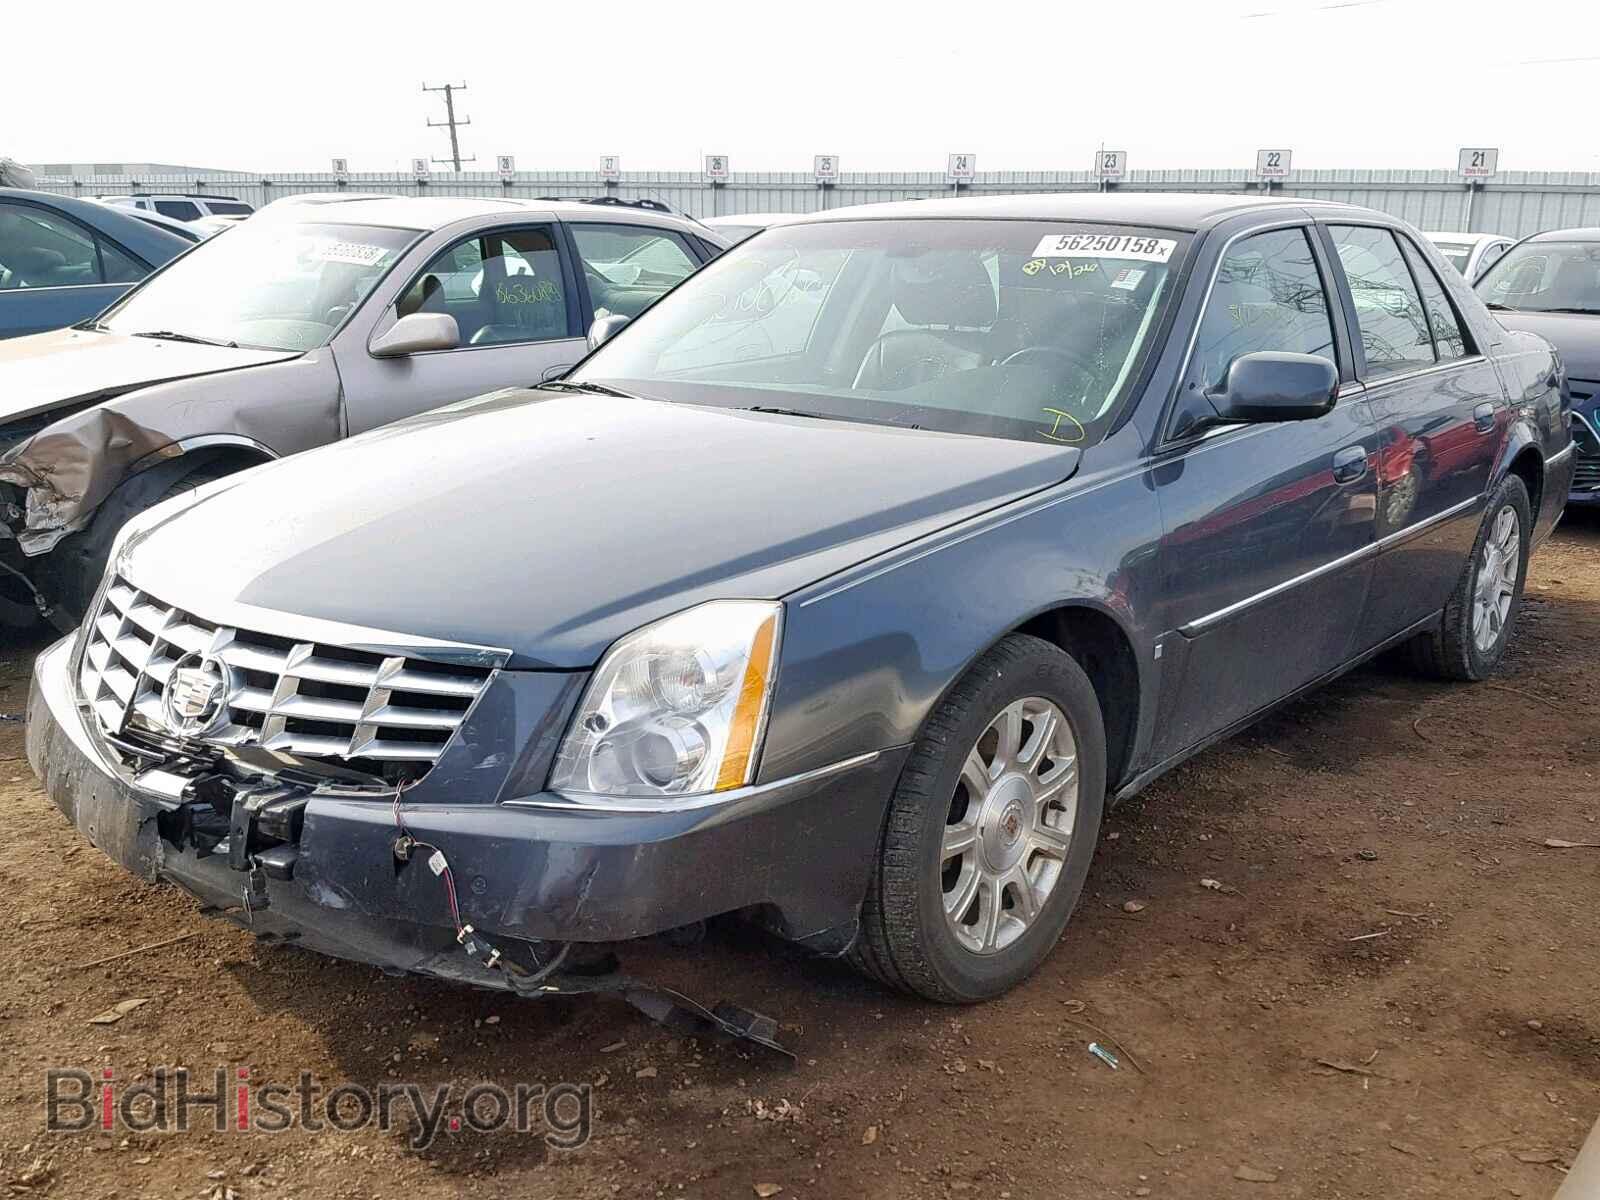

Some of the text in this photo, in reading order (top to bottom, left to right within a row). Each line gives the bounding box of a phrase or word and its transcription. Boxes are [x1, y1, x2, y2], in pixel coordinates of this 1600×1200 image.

[821, 157, 831, 170] 25
[956, 156, 967, 170] 24
[1104, 154, 1117, 168] 23
[1267, 152, 1281, 167] 22
[1471, 151, 1485, 167] 21
[1035, 407, 1085, 442] D
